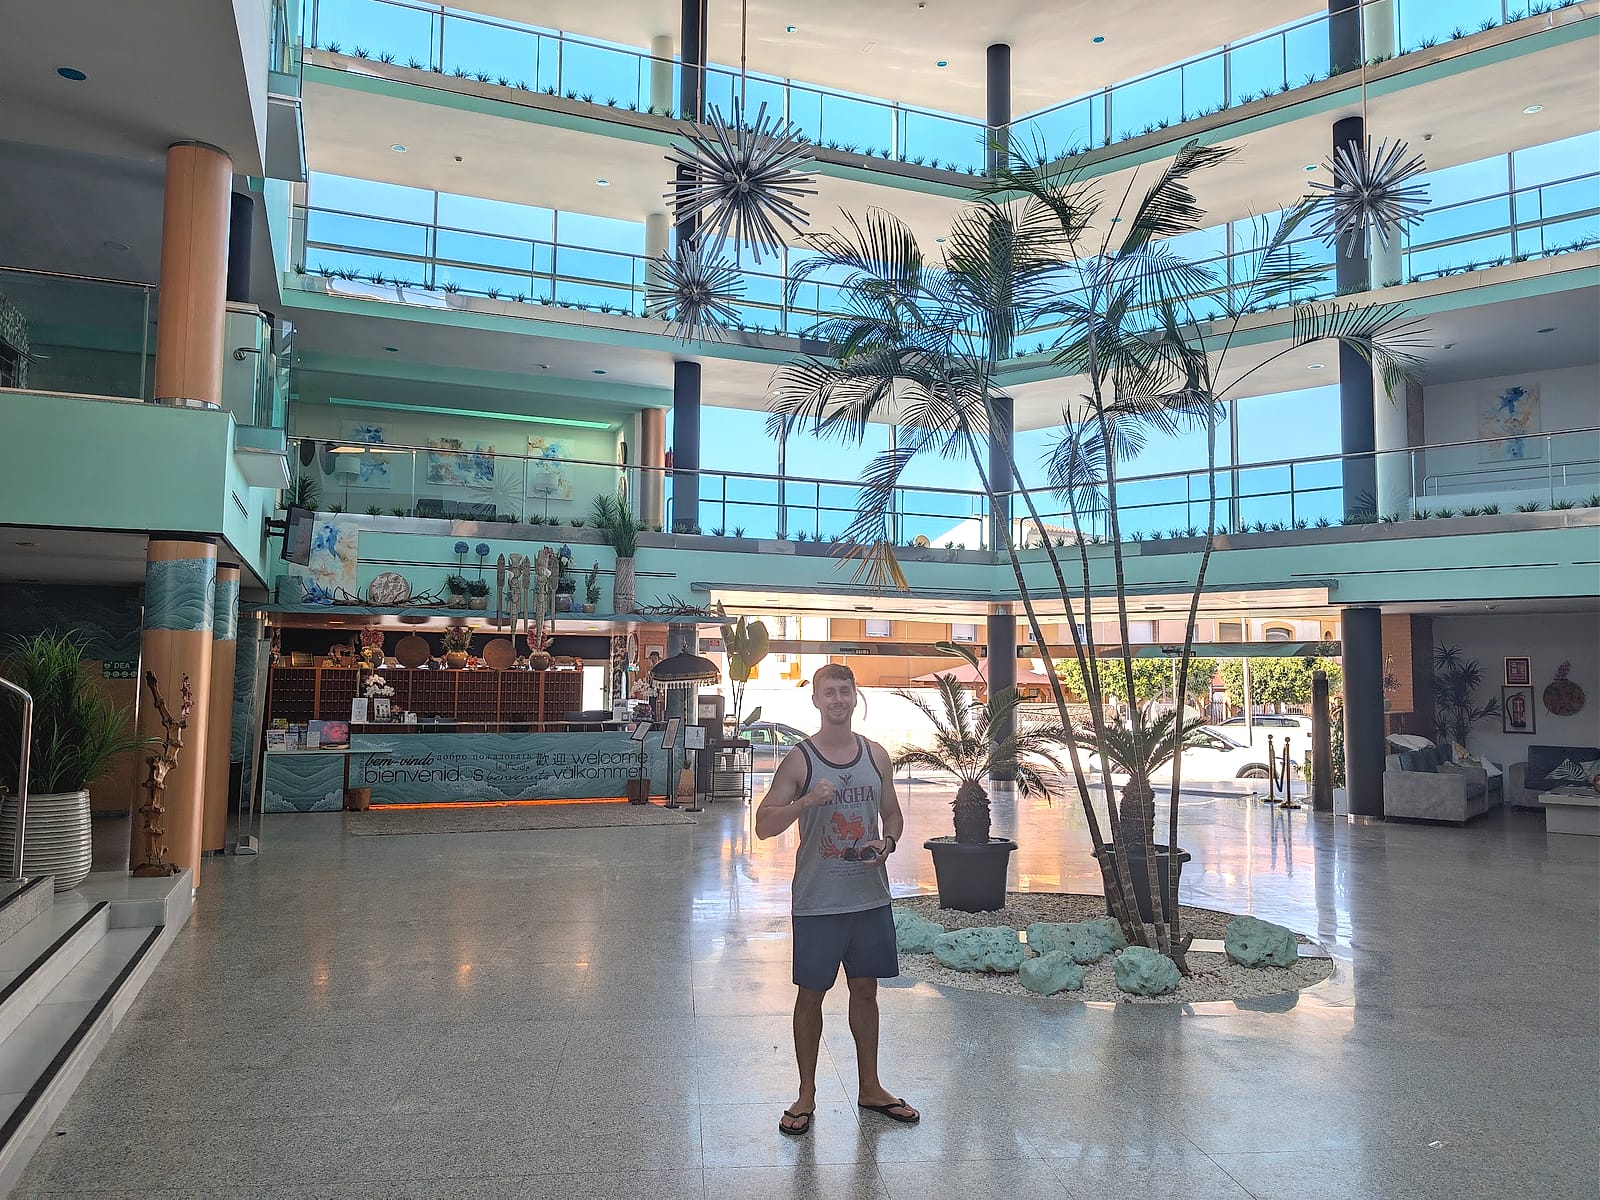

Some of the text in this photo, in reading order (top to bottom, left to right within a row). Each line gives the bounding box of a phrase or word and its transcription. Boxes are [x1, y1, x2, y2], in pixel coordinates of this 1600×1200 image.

[365, 751, 434, 767] bem-vindo
[571, 749, 649, 765] welcome
[552, 764, 649, 780] välkommen
